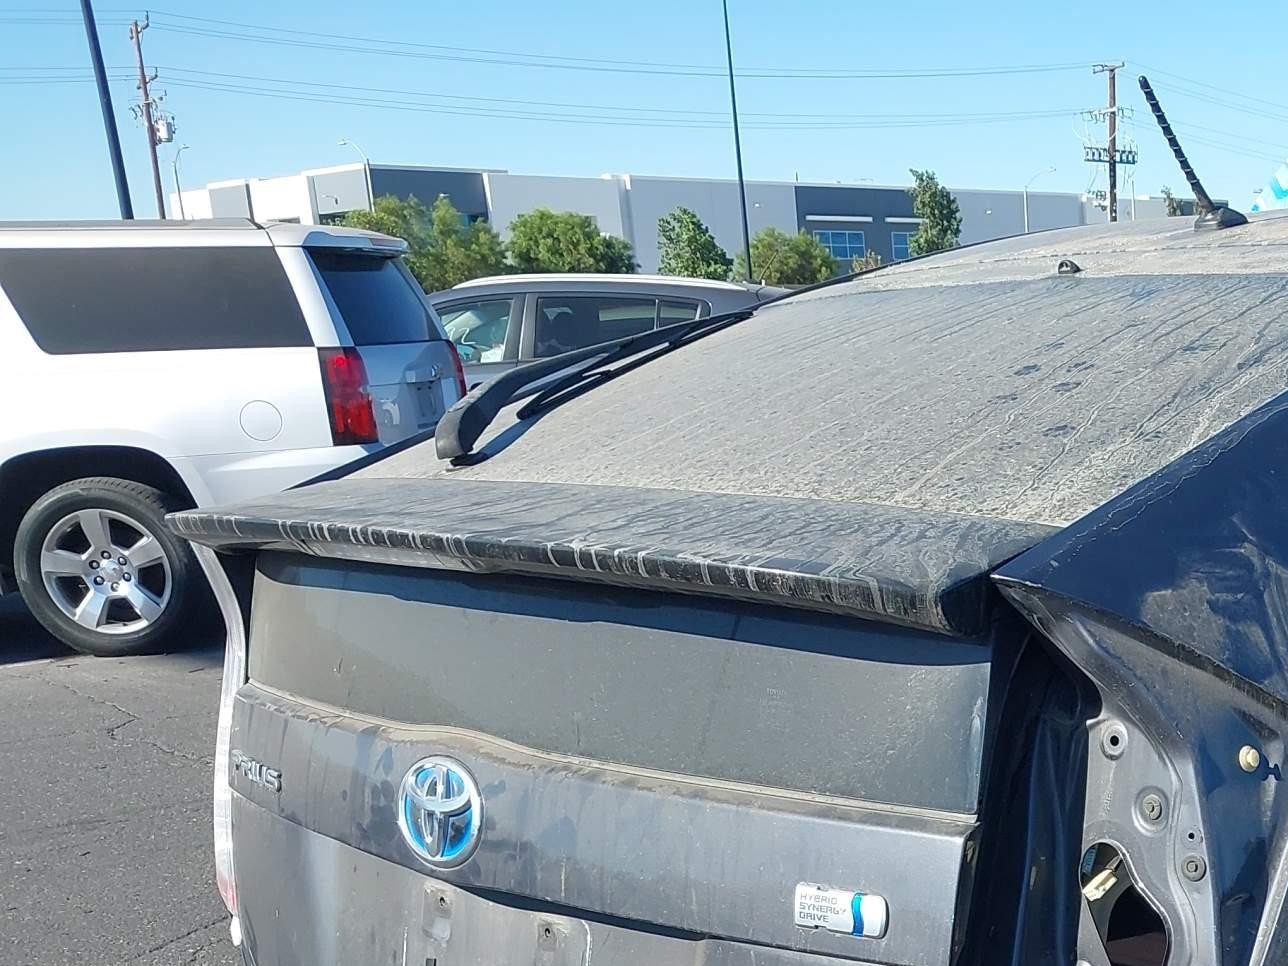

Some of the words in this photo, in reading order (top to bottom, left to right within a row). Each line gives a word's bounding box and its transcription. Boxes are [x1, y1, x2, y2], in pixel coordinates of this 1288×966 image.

[231, 749, 283, 793] PRIUS
[799, 890, 838, 905] HYBRID
[799, 901, 847, 915] SYNERGY
[799, 911, 830, 923] DRIVE
